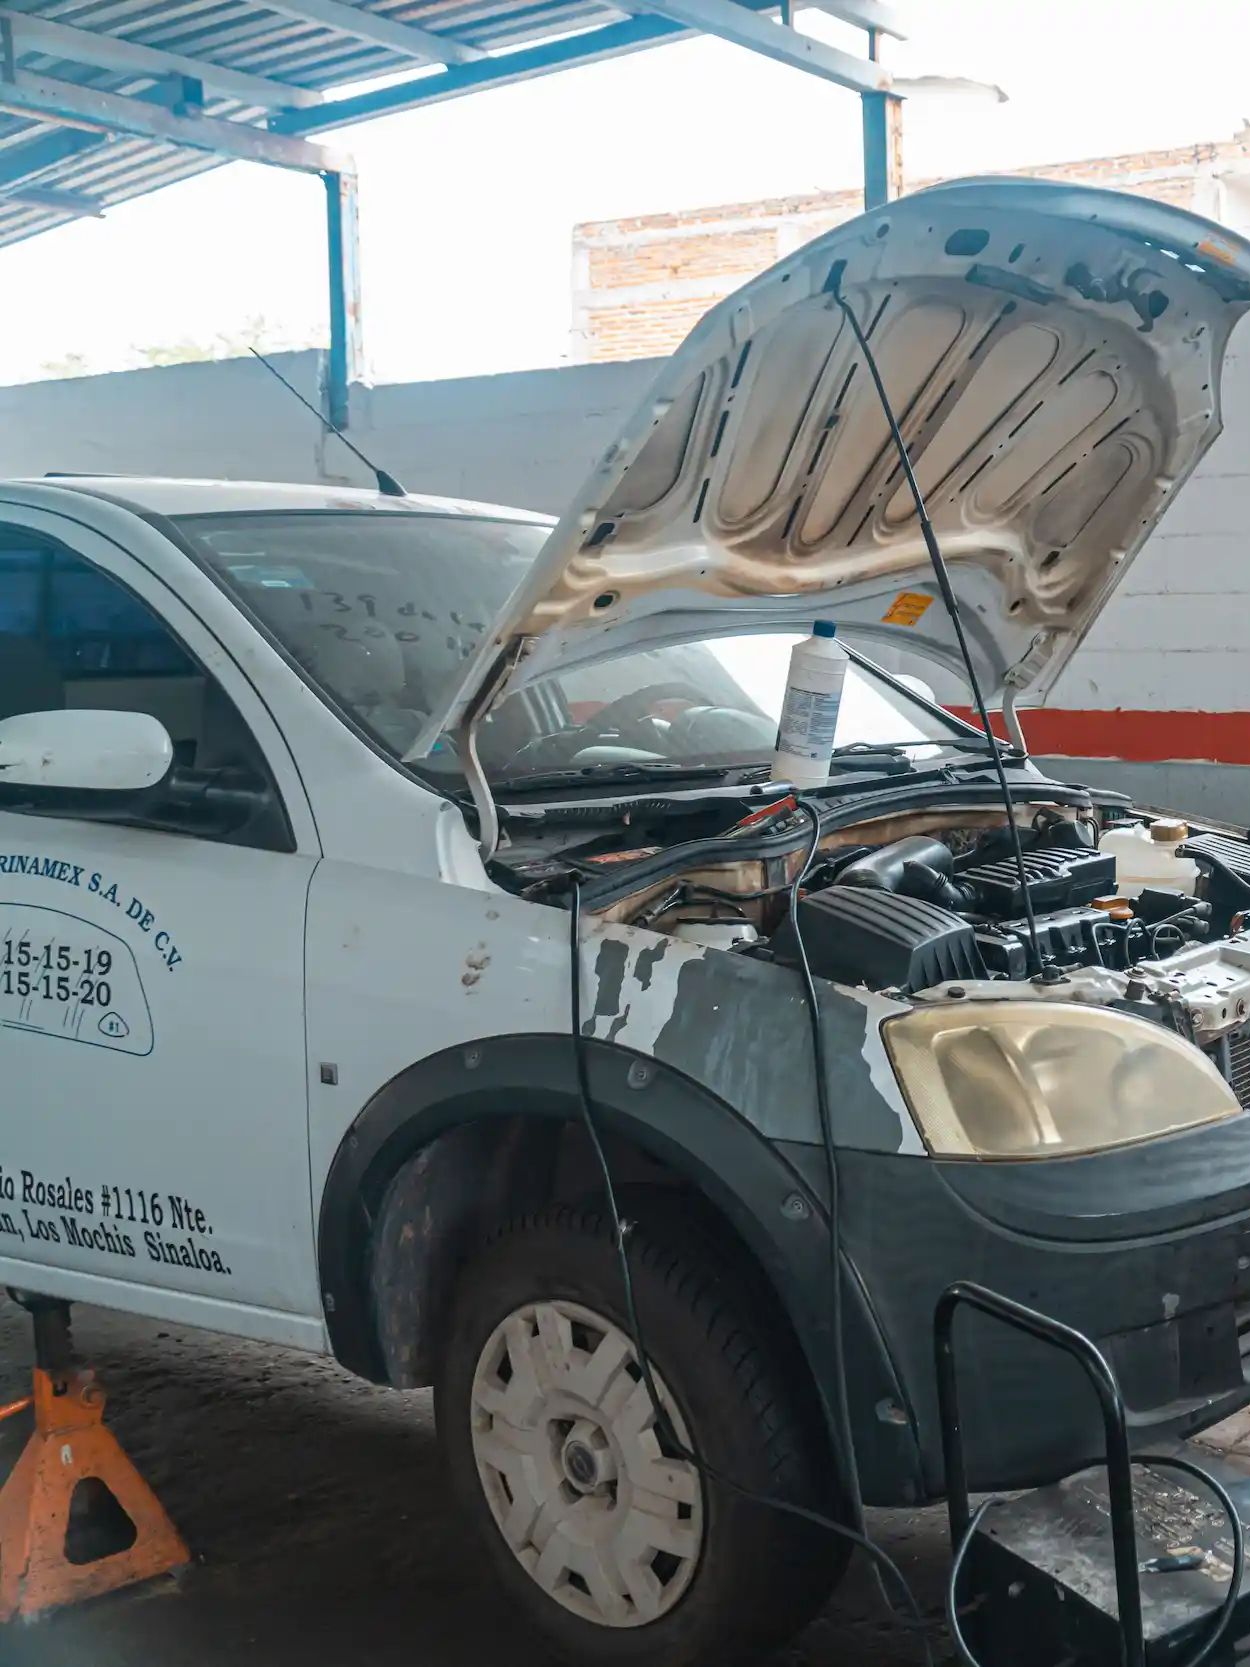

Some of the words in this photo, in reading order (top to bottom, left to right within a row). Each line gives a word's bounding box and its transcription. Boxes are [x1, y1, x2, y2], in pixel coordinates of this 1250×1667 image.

[88, 872, 121, 907] S.A.
[125, 897, 155, 932] DE
[154, 931, 182, 972] C.V.
[3, 970, 111, 1007] 15-15-20
[4, 940, 112, 976] 15-15-19
[20, 1170, 94, 1214] Rosales
[101, 1184, 163, 1227] #1116
[168, 1195, 213, 1235] Nte.
[21, 1208, 60, 1243] Los
[60, 1215, 136, 1258] Mochis
[143, 1230, 232, 1275] Sinaloa.
